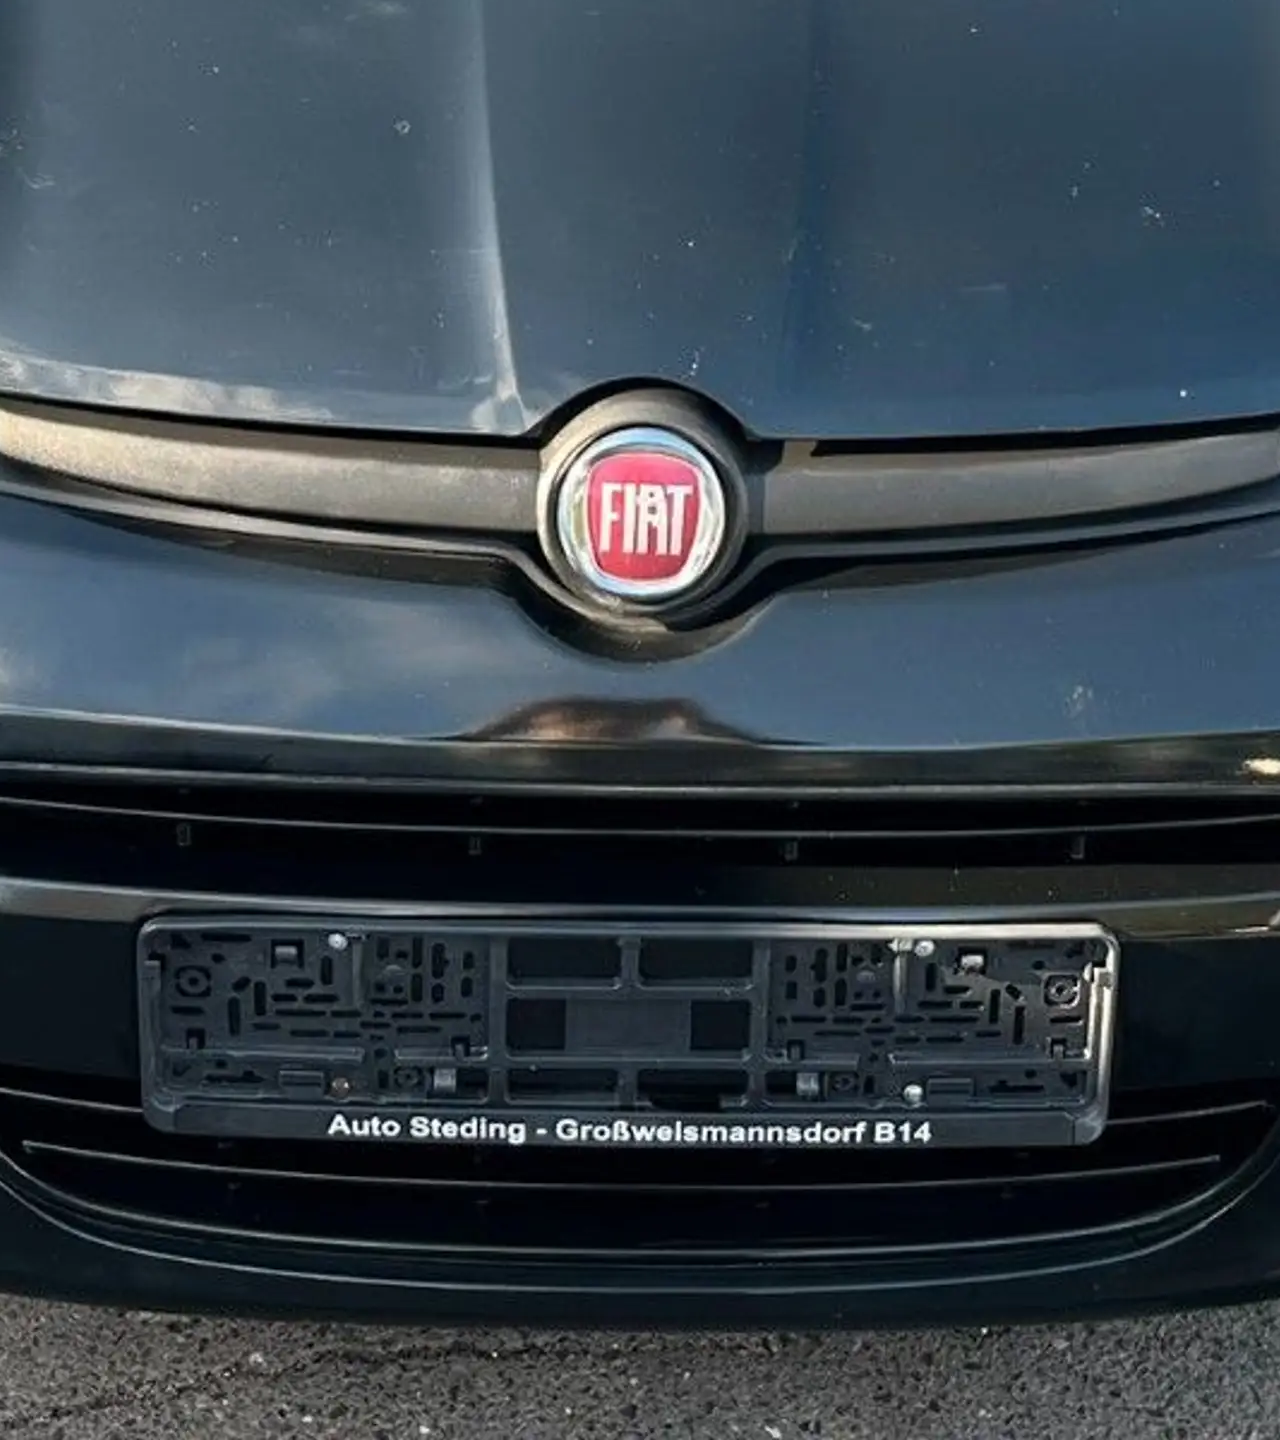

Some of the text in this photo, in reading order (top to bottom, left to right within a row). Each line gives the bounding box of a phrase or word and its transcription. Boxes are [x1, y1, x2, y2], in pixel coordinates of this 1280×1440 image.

[599, 482, 694, 556] FIAT
[328, 1114, 401, 1137] Auto
[409, 1115, 527, 1145] Steding
[874, 1122, 933, 1144] B14
